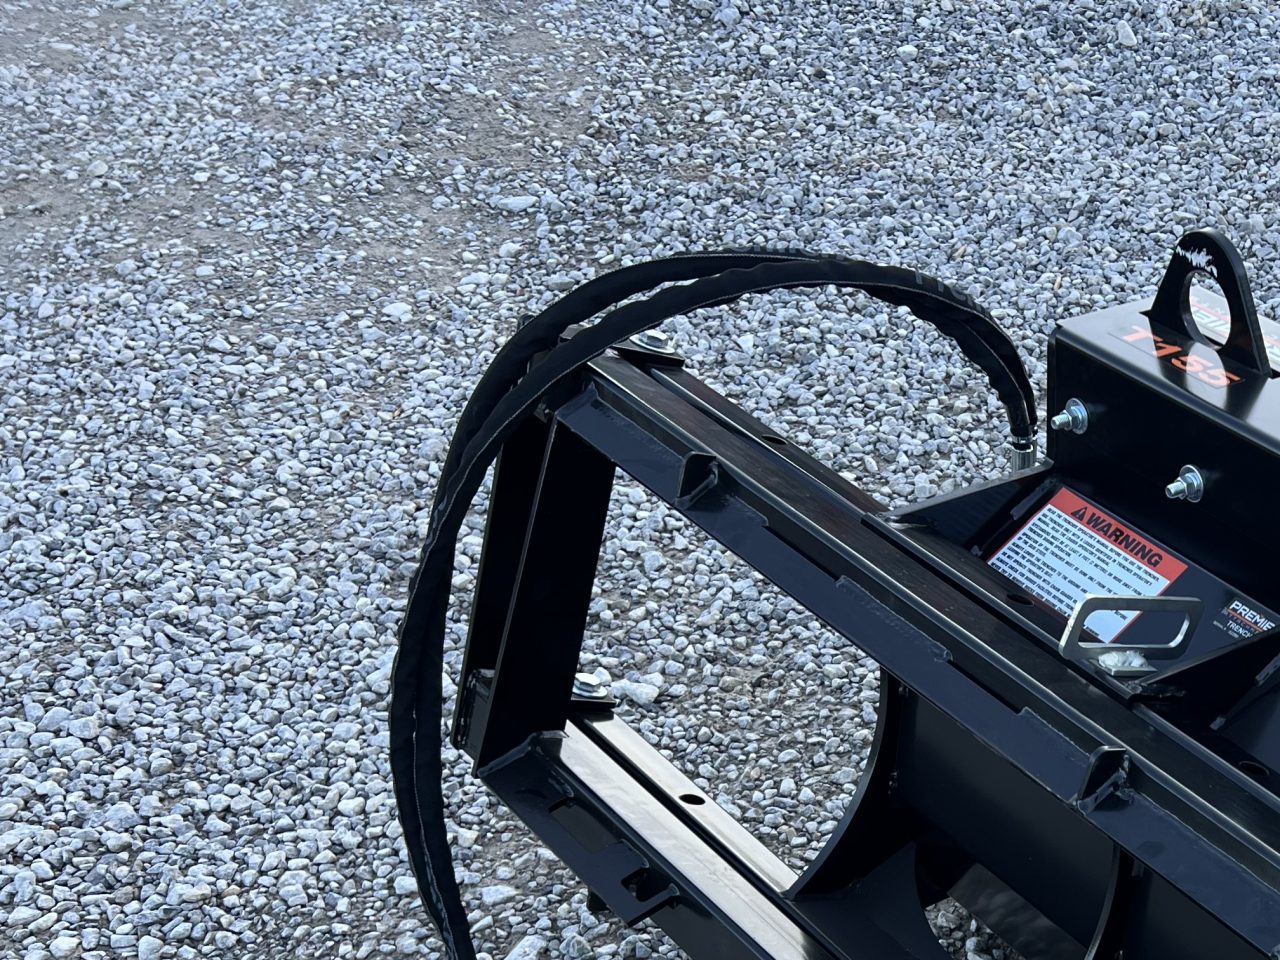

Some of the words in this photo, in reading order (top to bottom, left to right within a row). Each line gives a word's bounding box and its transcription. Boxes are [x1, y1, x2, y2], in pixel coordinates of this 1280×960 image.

[1087, 511, 1163, 568] WARNING
[1226, 620, 1254, 638] TRENCH
[1229, 600, 1276, 631] PREMIE
